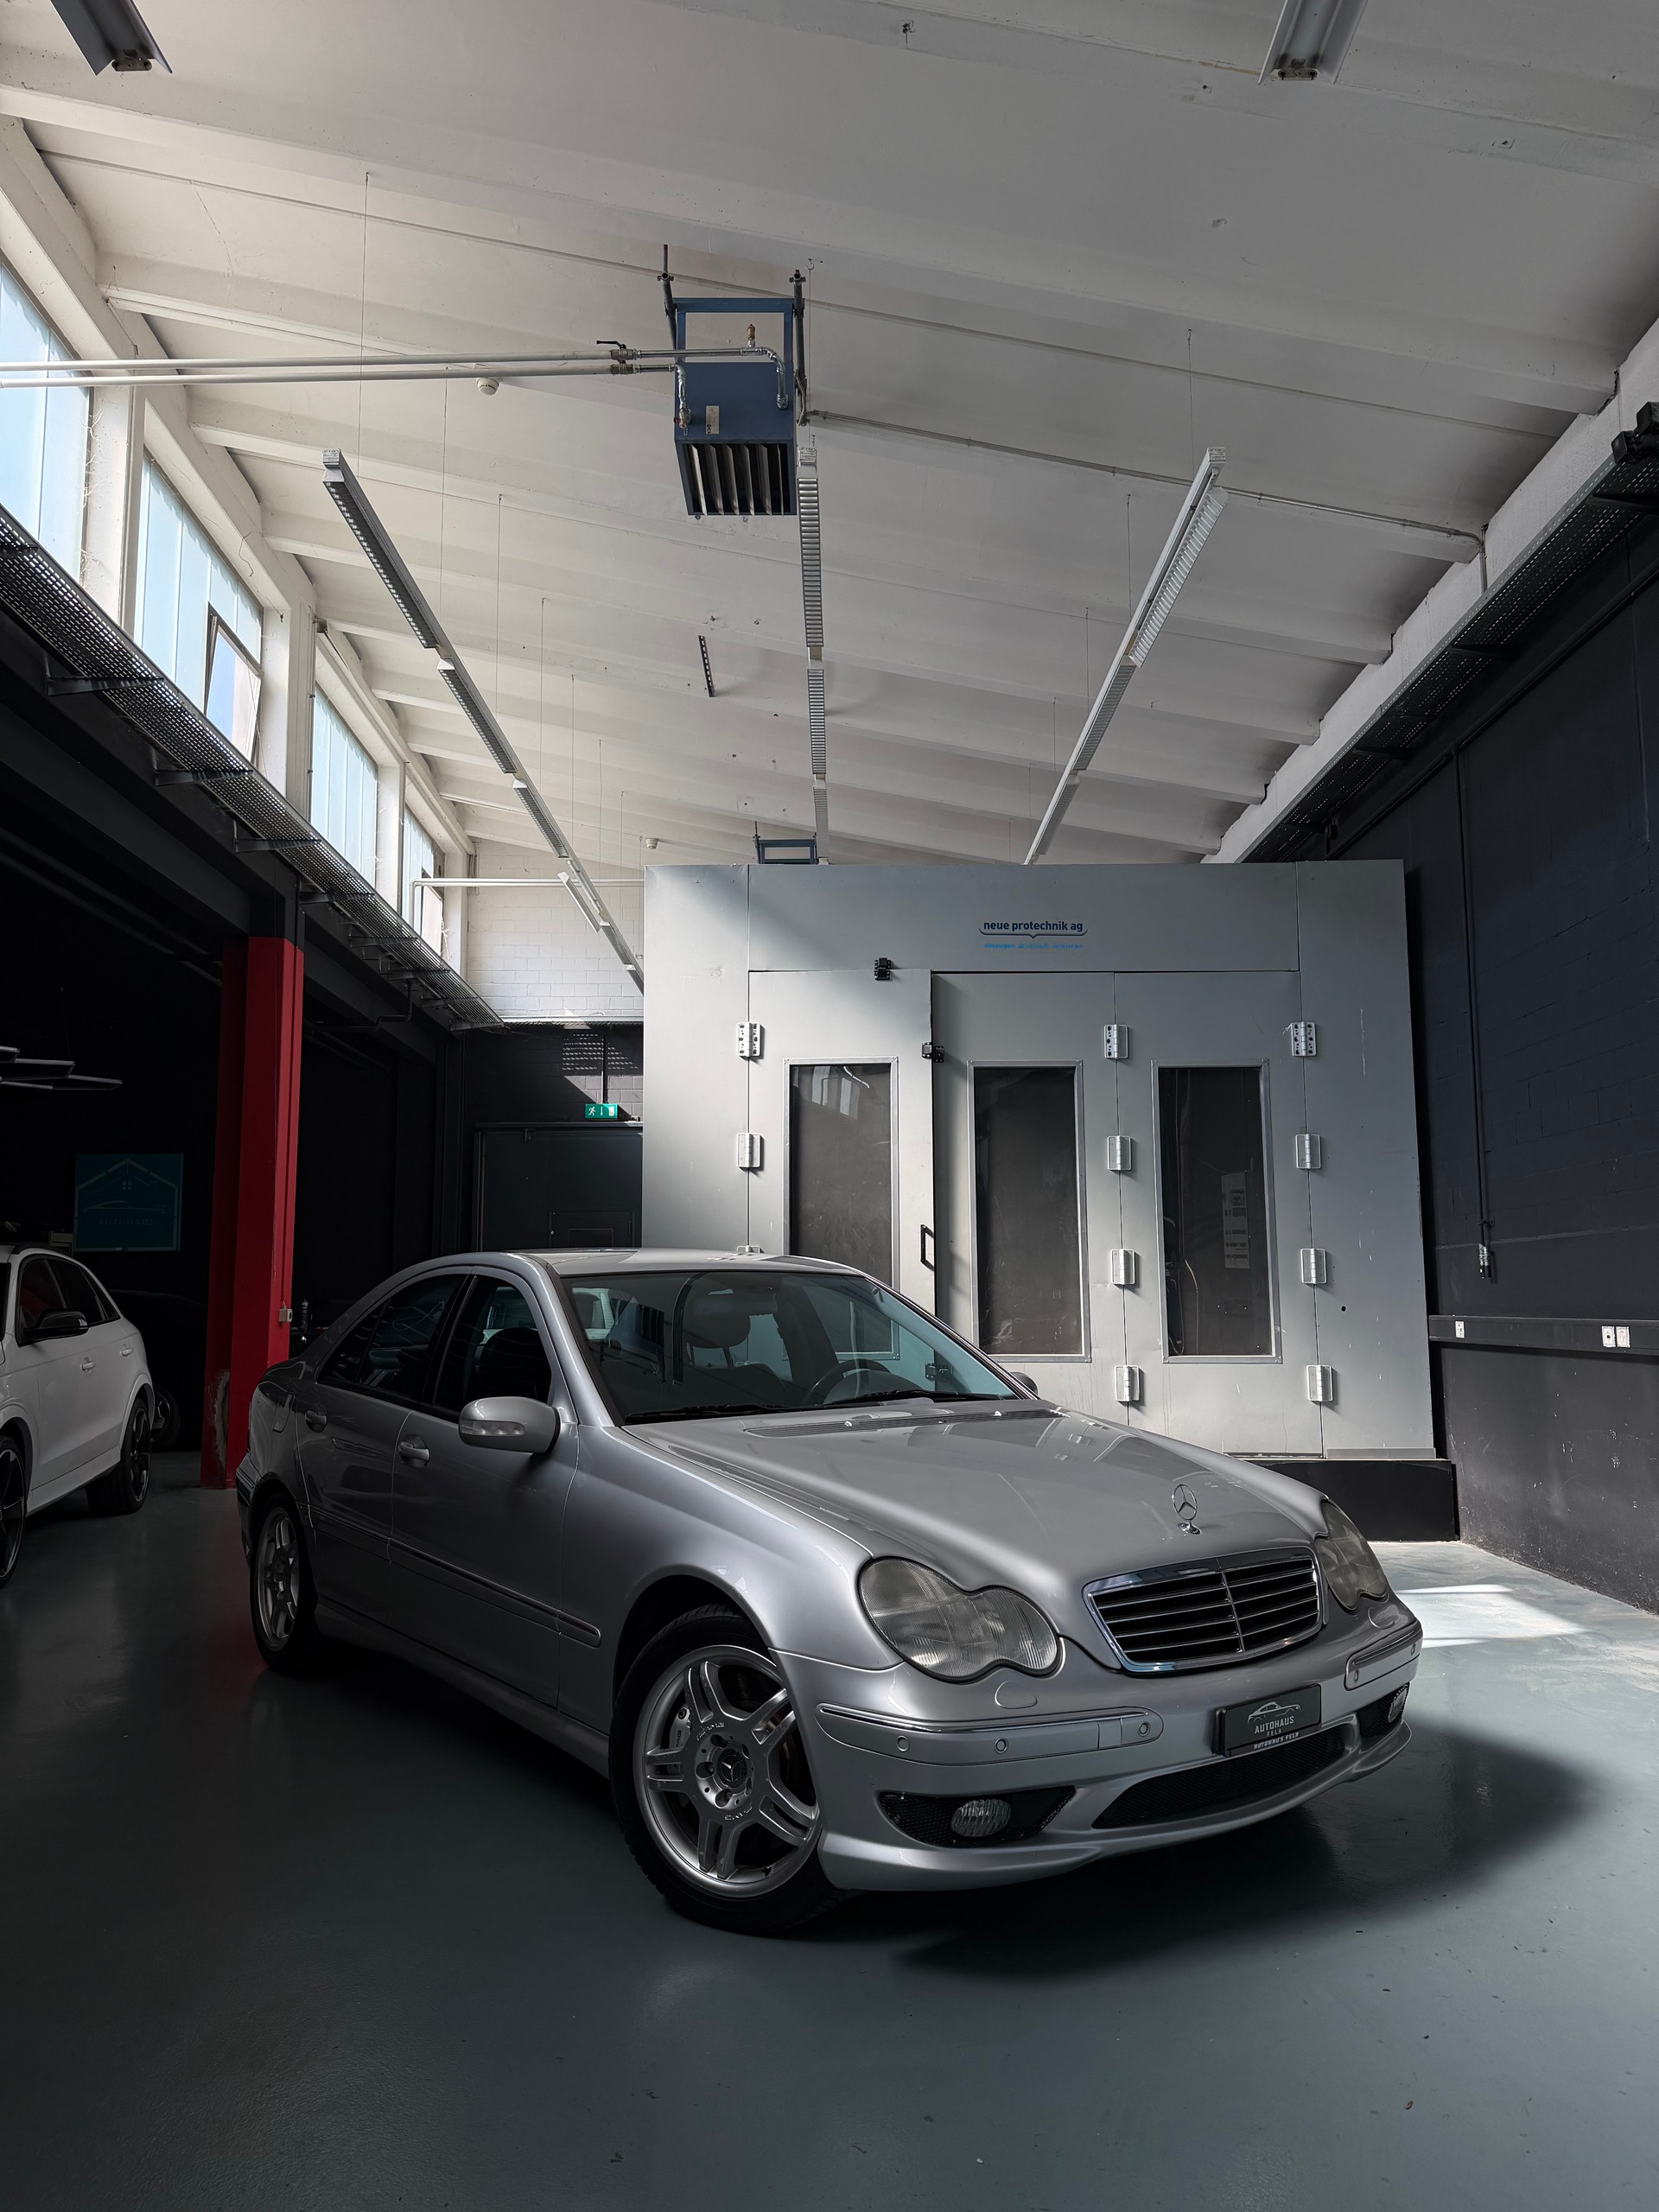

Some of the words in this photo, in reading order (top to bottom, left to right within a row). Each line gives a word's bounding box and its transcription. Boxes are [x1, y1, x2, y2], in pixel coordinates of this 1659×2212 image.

[983, 921, 1010, 931] neue
[1012, 920, 1068, 931] protechnik
[1071, 922, 1083, 931] ag
[1255, 1715, 1294, 1734] AUTOHAUS
[1267, 1728, 1282, 1737] FELA
[1253, 1736, 1284, 1750] AUTOHAUS
[1285, 1732, 1300, 1740] FELA
